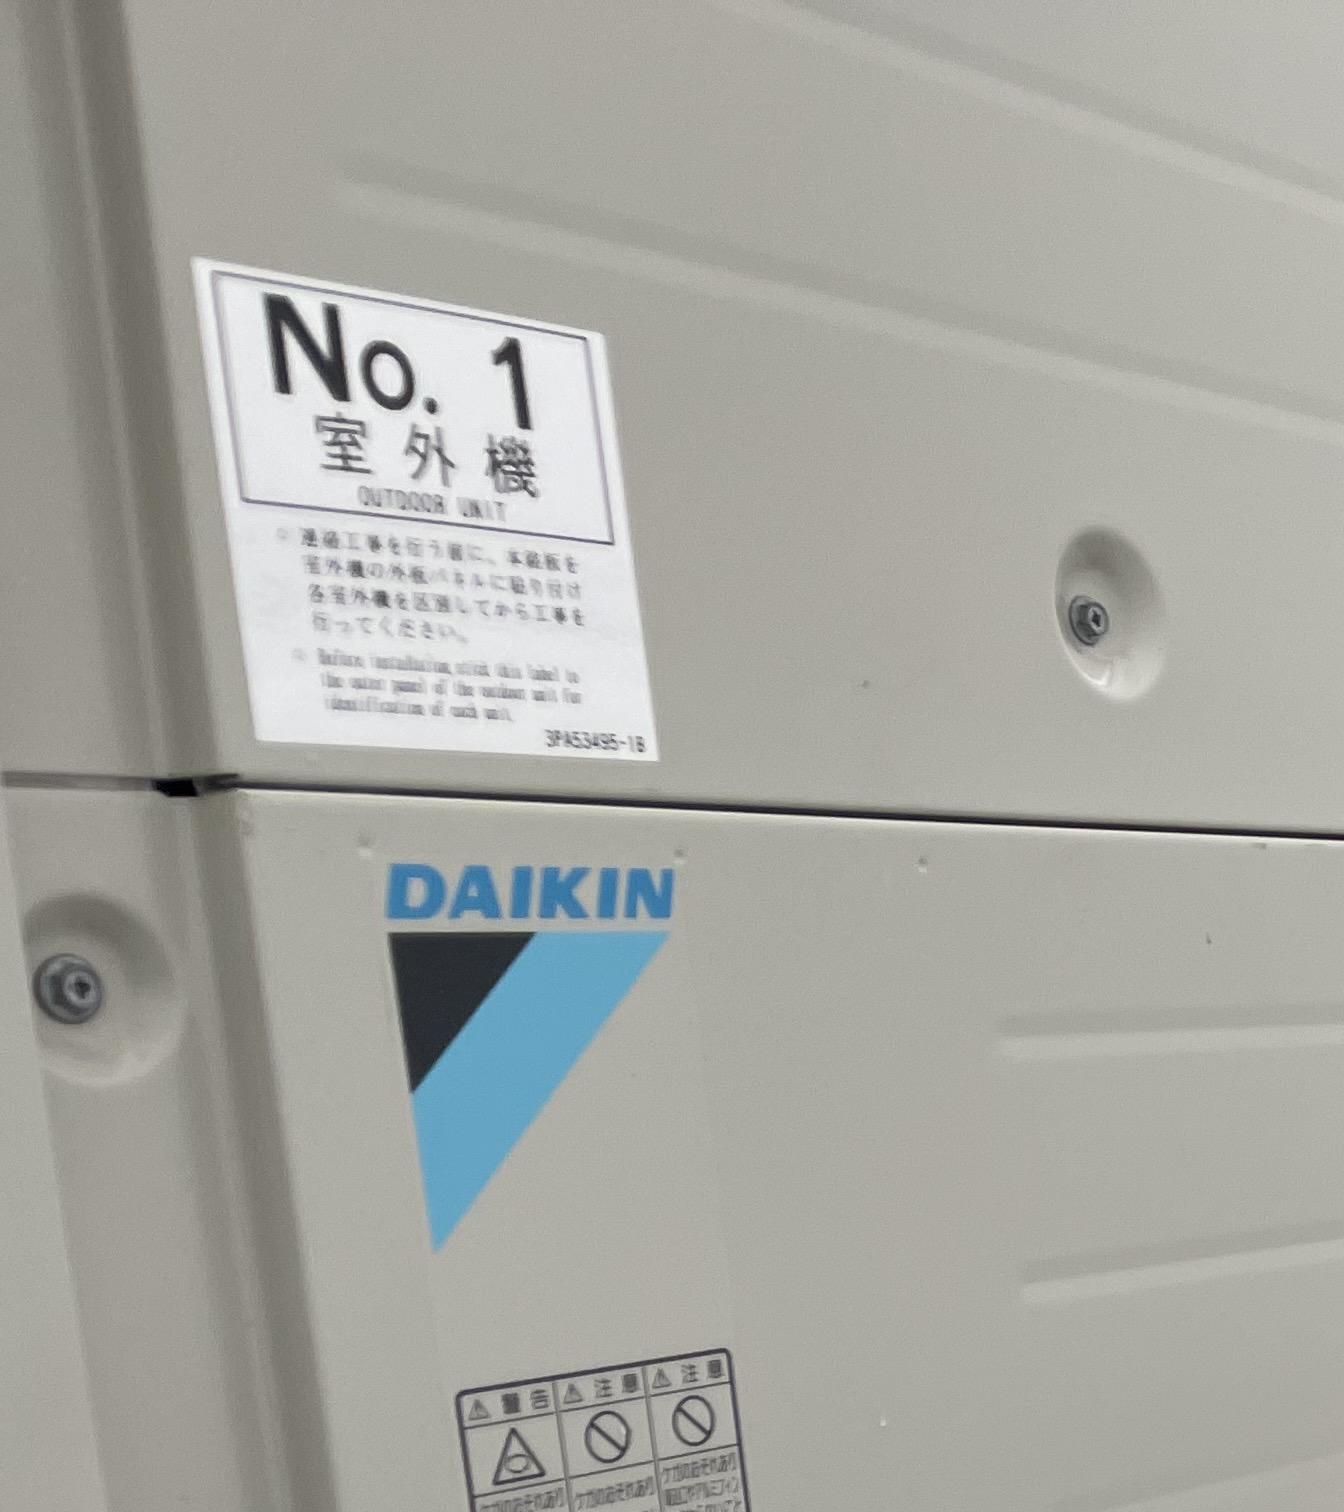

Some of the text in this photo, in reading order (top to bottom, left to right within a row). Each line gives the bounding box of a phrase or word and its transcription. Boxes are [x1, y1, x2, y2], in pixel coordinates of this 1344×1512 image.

[262, 293, 533, 430] No. 1
[314, 411, 541, 498] 室外機
[357, 486, 508, 521] OUTDOOR UNIT
[385, 862, 676, 920] DAIKIN
[594, 1373, 640, 1398] 注意
[681, 1359, 725, 1383] 注意
